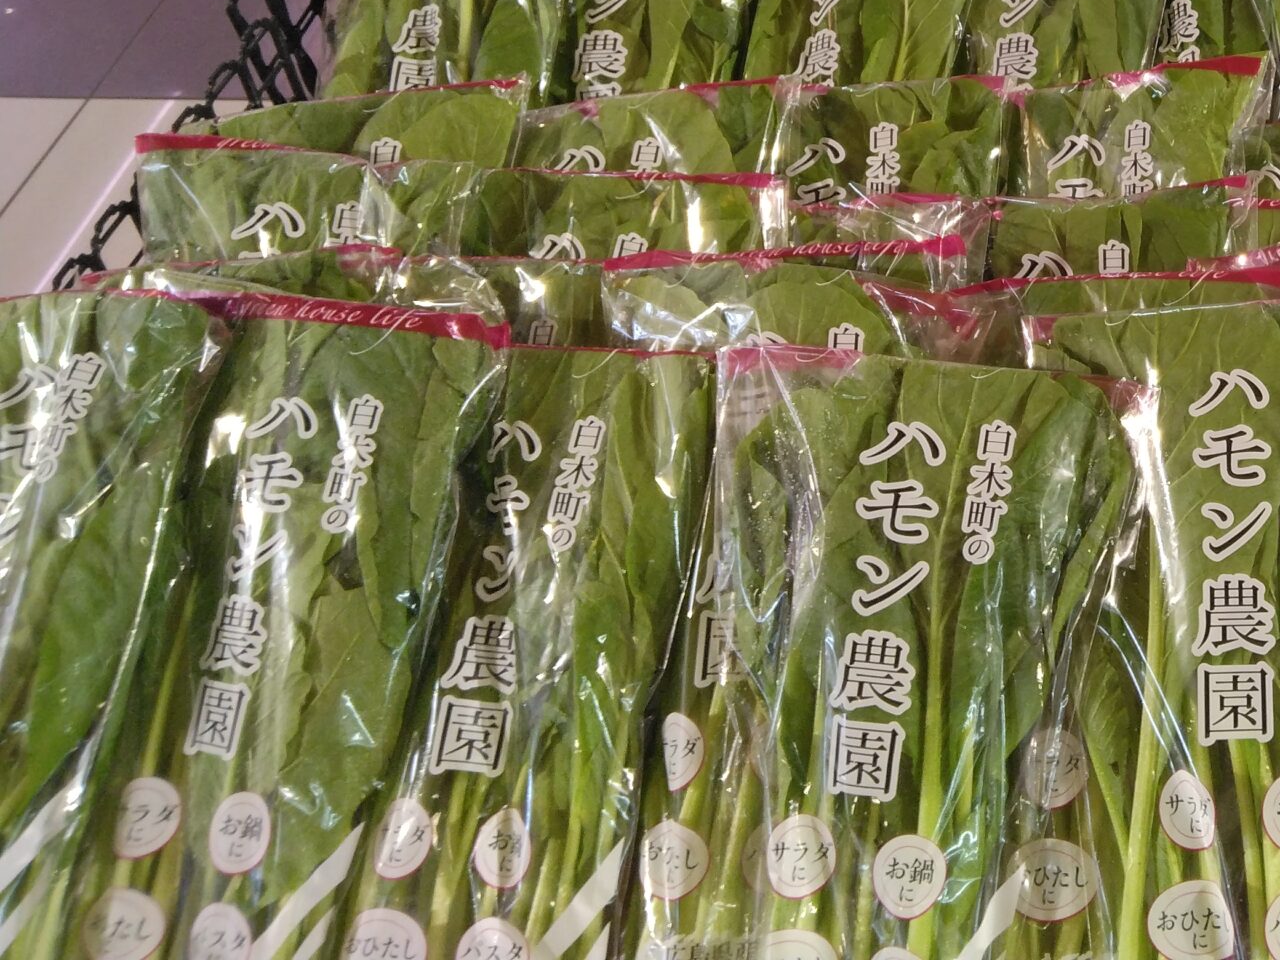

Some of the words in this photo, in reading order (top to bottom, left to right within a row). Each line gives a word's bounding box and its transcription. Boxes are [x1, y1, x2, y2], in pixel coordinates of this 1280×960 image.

[295, 300, 365, 323] house
[548, 415, 606, 553] 白木町の
[961, 419, 1017, 564] 白木町の
[1189, 368, 1277, 746] ハモン農園
[828, 420, 946, 801] ハモン農園
[220, 812, 264, 840] お鍋
[770, 840, 832, 862] サラダ
[791, 864, 807, 882] に
[885, 856, 935, 885] お鍋
[899, 884, 916, 904] に
